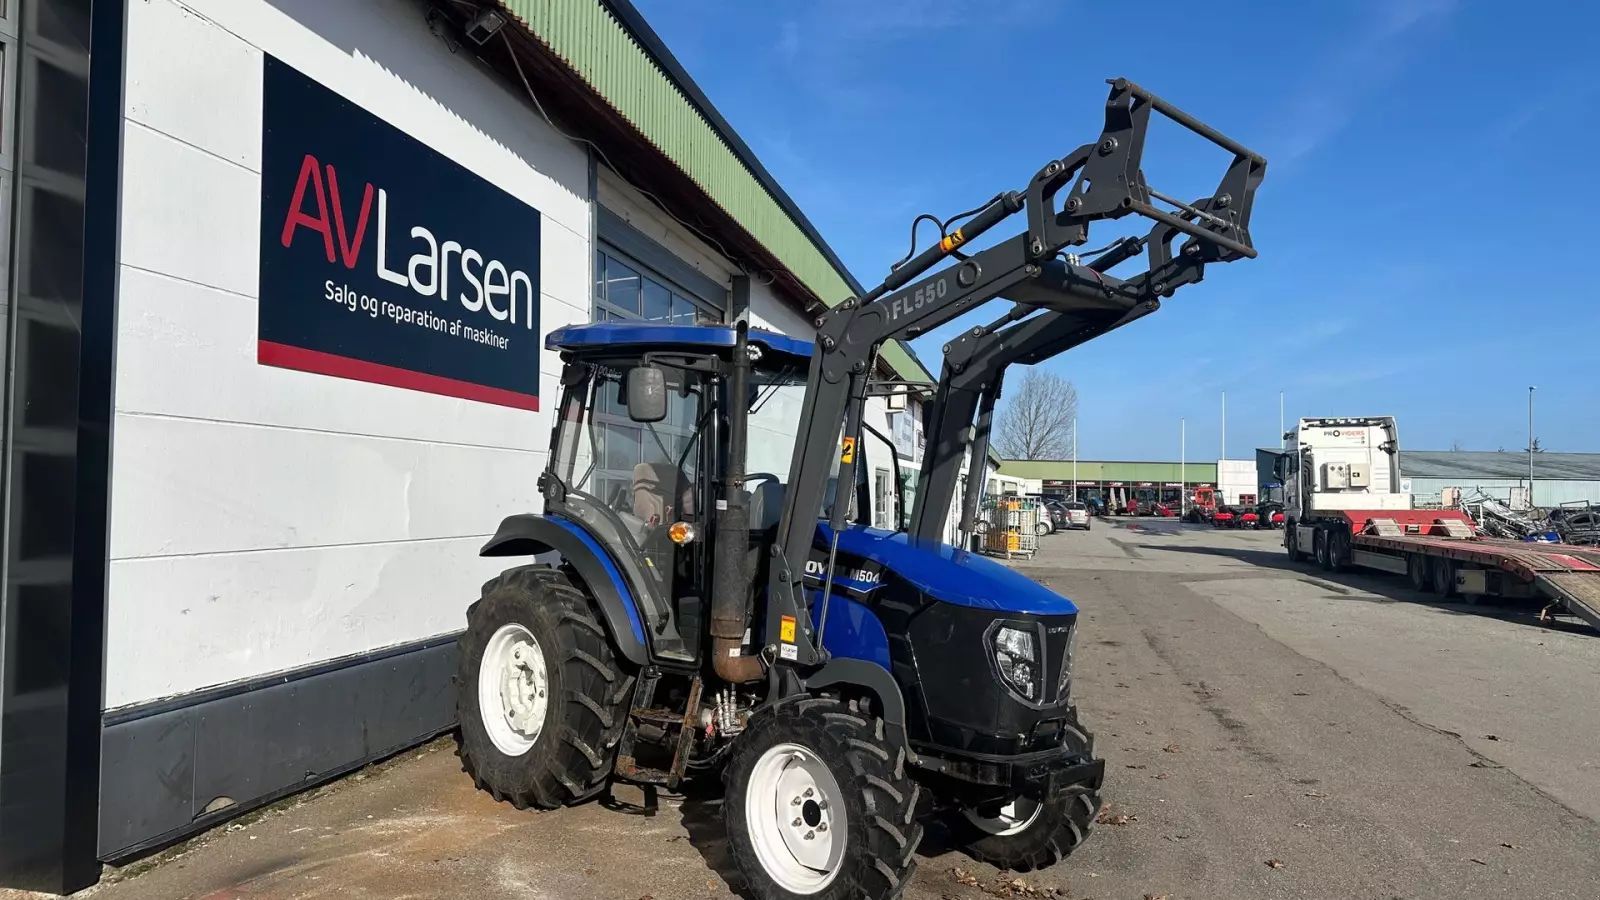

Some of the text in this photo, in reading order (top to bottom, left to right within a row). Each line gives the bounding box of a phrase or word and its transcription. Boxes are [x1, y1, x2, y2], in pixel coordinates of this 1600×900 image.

[324, 279, 509, 350] Salg og reparation af maskiner
[892, 279, 947, 320] FL550
